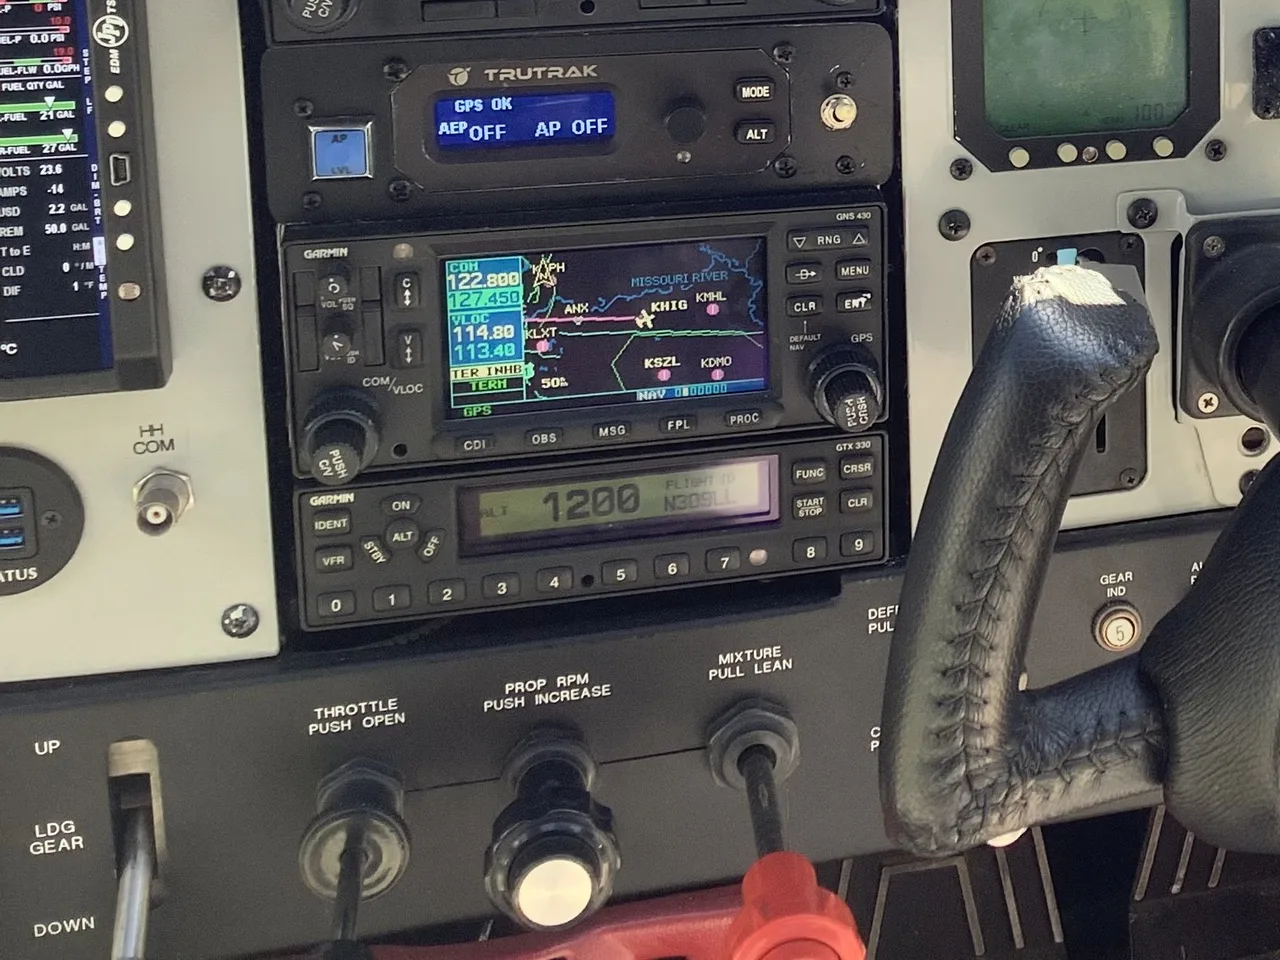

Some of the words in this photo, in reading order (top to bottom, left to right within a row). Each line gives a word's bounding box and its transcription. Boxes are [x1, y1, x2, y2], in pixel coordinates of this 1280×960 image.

[110, 49, 120, 74] EDM
[484, 65, 598, 82] TRUTRAK
[2, 83, 22, 91] FUEL
[27, 82, 44, 90] QTY
[46, 81, 64, 89] GAL
[742, 86, 770, 98] MODE
[454, 99, 483, 113] GPS
[491, 97, 512, 110] OK
[469, 125, 506, 141] OFF
[535, 122, 561, 138] AP
[572, 118, 608, 134] OFF
[746, 129, 767, 140] ALT
[818, 235, 841, 244] RNG
[304, 248, 348, 259] GARMIN
[2, 266, 25, 276] CLD
[842, 266, 869, 276] MENU
[448, 272, 519, 289] 122.800
[631, 273, 689, 287] MISSOURI
[692, 271, 728, 282] RIVER
[3, 286, 21, 296] DIF
[651, 300, 688, 312] KHIG
[794, 302, 816, 311] CLR
[453, 325, 515, 342] 114.80
[851, 334, 873, 342] GPS
[644, 357, 681, 368] KSZL
[667, 420, 690, 430] FPL
[730, 413, 759, 425] PROC
[139, 424, 163, 437] HH
[599, 425, 626, 436] MSG
[532, 434, 557, 444] OBS
[133, 439, 175, 455] COM
[796, 468, 824, 479] FUNC
[843, 463, 871, 474] CRSR
[310, 493, 354, 506] GARMIN
[542, 484, 640, 522] 1200
[848, 497, 868, 508] CLR
[392, 501, 410, 511] ON
[315, 519, 348, 530] IDENT
[392, 531, 414, 541] ALT
[322, 556, 345, 565] VFR
[1100, 572, 1133, 585] GEAR
[1107, 586, 1126, 597] IND
[1116, 625, 1125, 641] 5
[718, 646, 781, 665] MIXTURE
[709, 666, 744, 680] PULL
[754, 659, 792, 674] LEAN
[505, 679, 546, 694] PROP
[557, 673, 589, 687] RPM
[484, 696, 525, 712] PUSH
[534, 684, 611, 706] INCREASE
[314, 698, 398, 720] THROTTLE
[309, 720, 351, 735] PUSH
[362, 712, 405, 728] OPEN
[35, 740, 61, 755] UP
[35, 821, 75, 838] LDG
[29, 836, 84, 855] GEAR
[34, 917, 95, 937] DOWN
